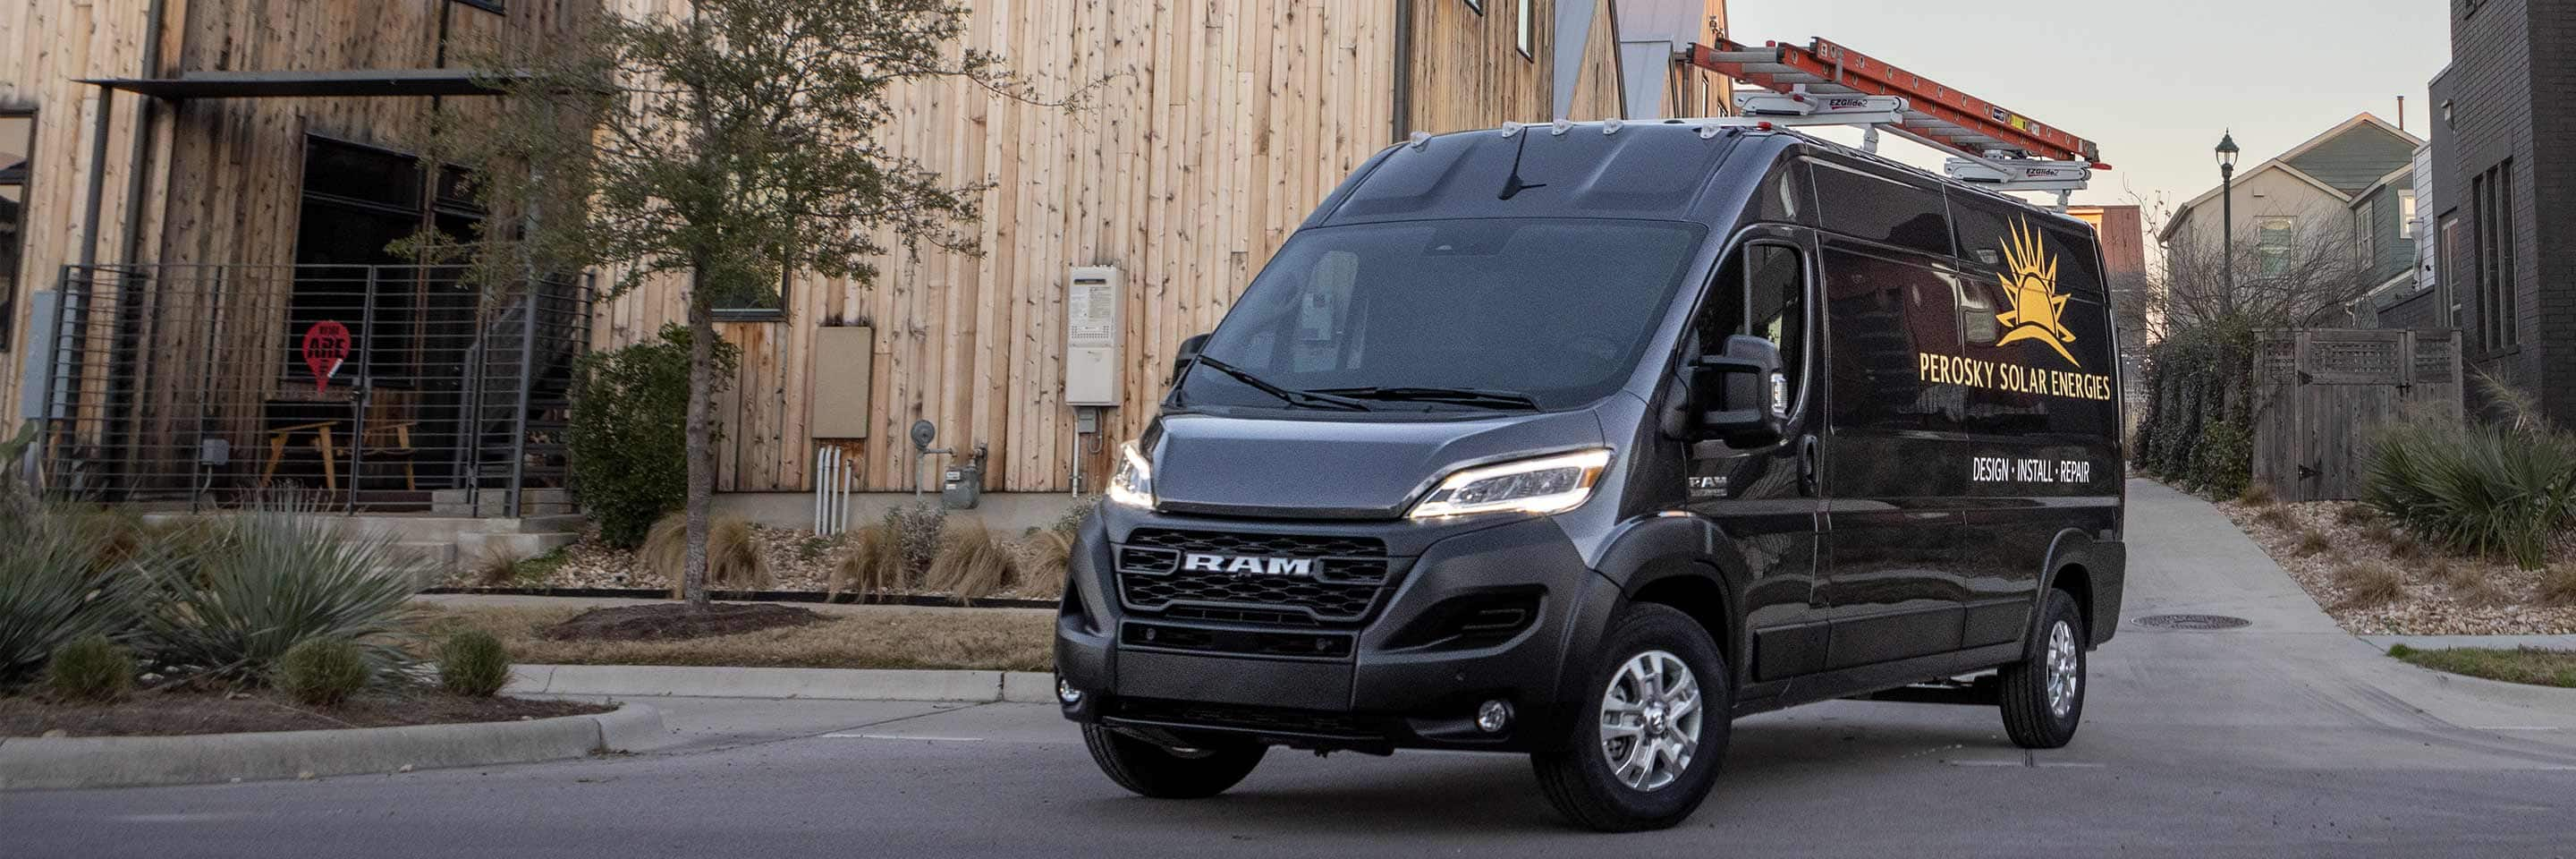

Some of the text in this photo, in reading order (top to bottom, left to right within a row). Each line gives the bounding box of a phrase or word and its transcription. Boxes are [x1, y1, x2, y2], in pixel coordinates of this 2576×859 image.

[1829, 98, 1868, 107] EZGlide2
[307, 337, 345, 359] ARE
[1919, 352, 2111, 401] PEROSKY SOLAR ENERGIES
[1973, 457, 2090, 483] DESIGN INSTALL REPAIR
[1183, 553, 1312, 576] RAM
